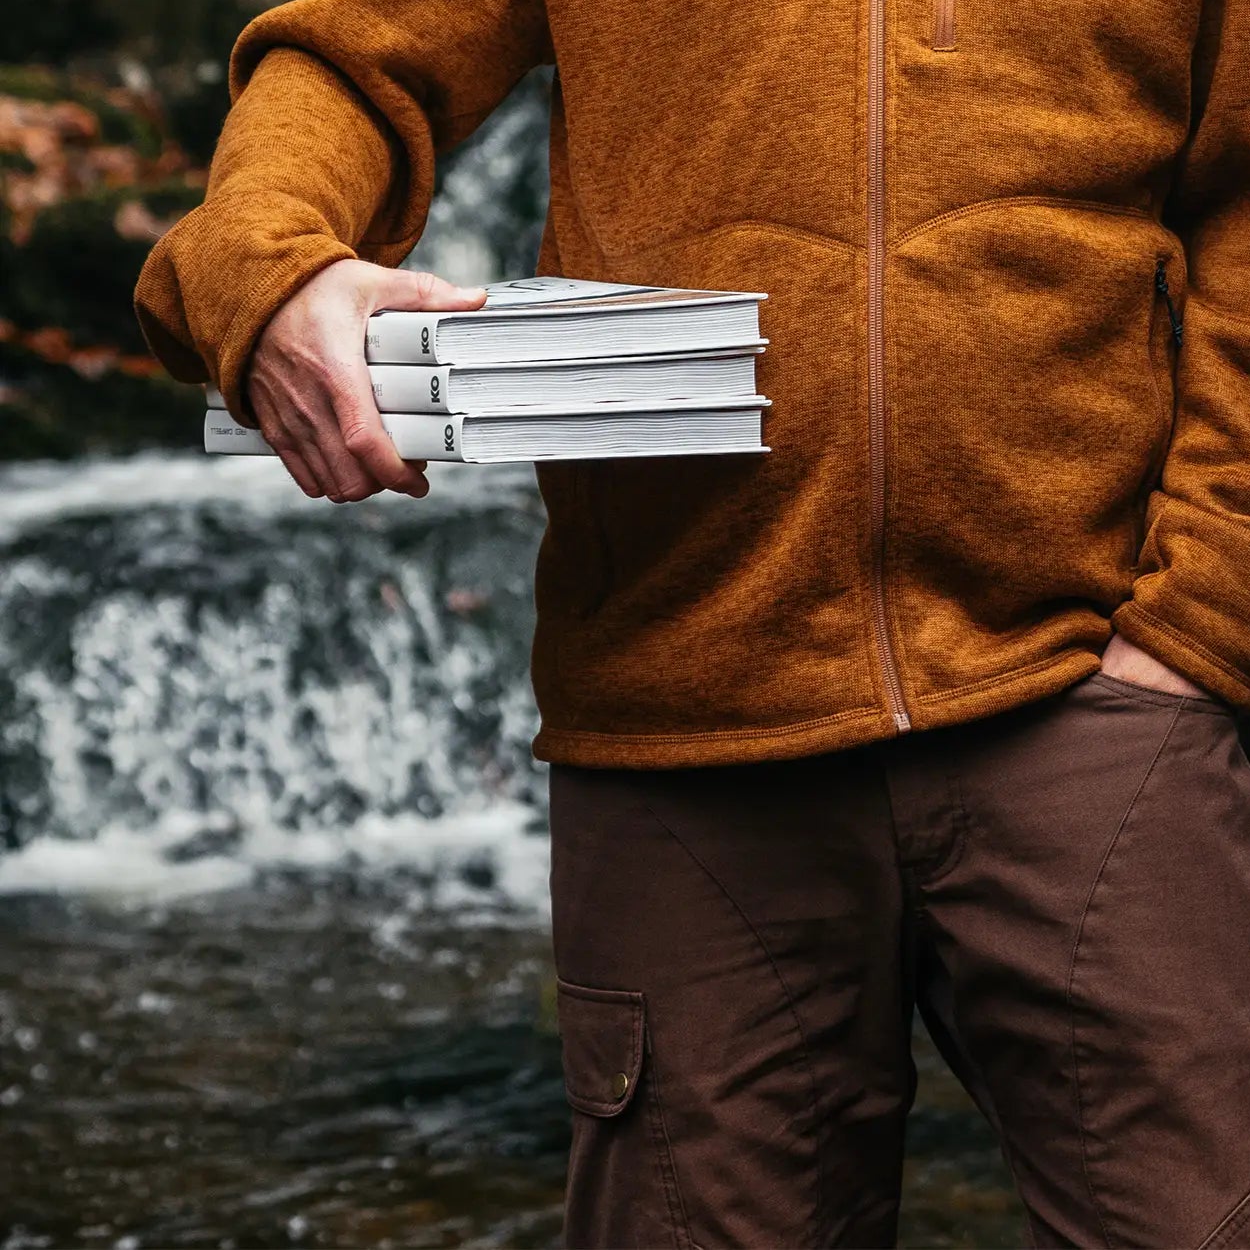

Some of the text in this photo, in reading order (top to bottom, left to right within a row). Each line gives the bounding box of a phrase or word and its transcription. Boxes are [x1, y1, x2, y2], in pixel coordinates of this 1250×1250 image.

[421, 326, 430, 354] KO
[430, 375, 440, 403] KO
[445, 424, 454, 451] KO
